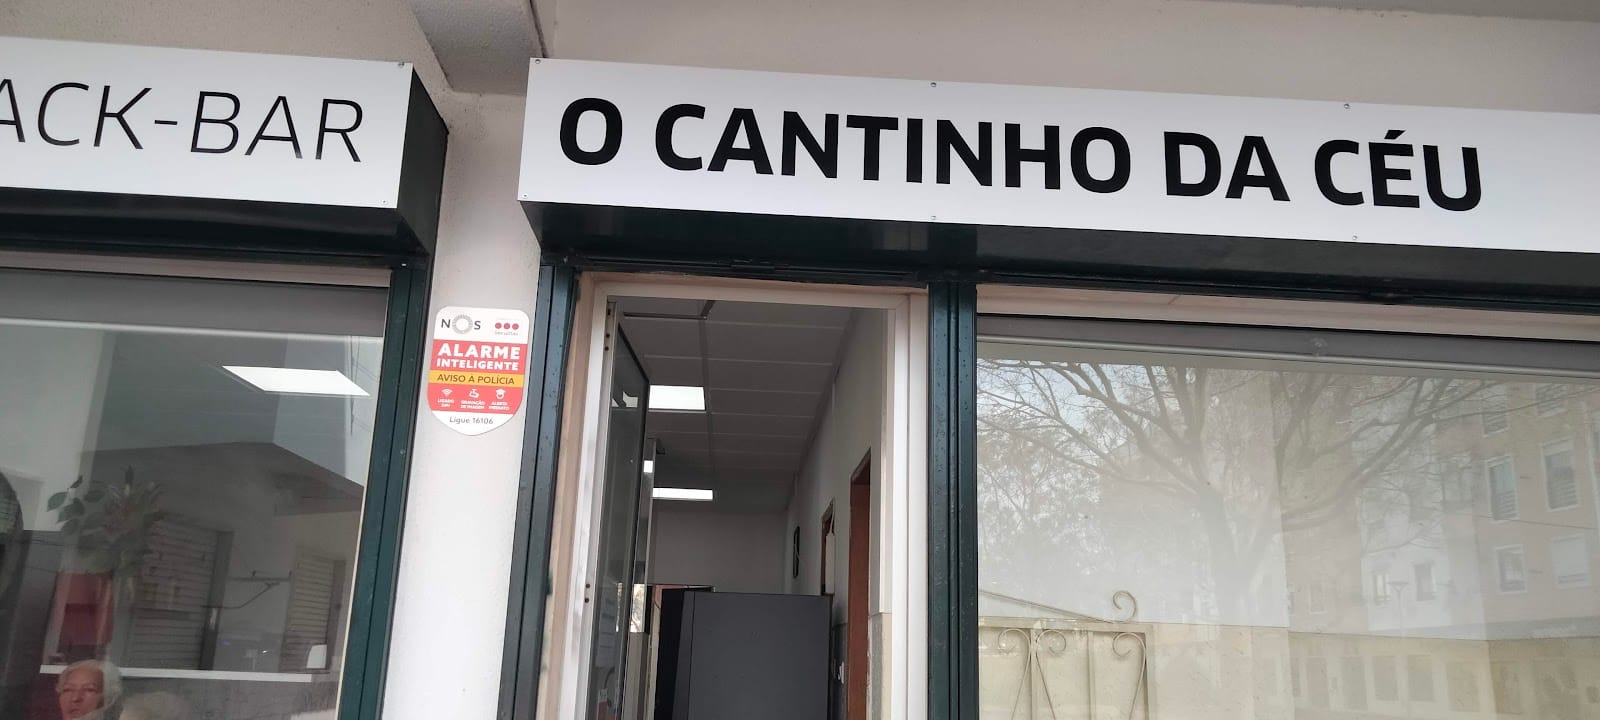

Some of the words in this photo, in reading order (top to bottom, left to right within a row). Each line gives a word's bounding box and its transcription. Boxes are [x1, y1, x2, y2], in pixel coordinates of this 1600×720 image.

[559, 97, 623, 166] O
[655, 103, 1131, 194] CANTINHO
[1163, 131, 1291, 202] DA
[1314, 129, 1482, 212] CÉU
[438, 343, 520, 360] ALARME
[437, 358, 519, 371] INTELIGENTE
[437, 374, 466, 383] AVISO
[477, 374, 515, 385] POLÍCIA
[449, 416, 470, 424] Ligue
[472, 417, 494, 425] 16106
